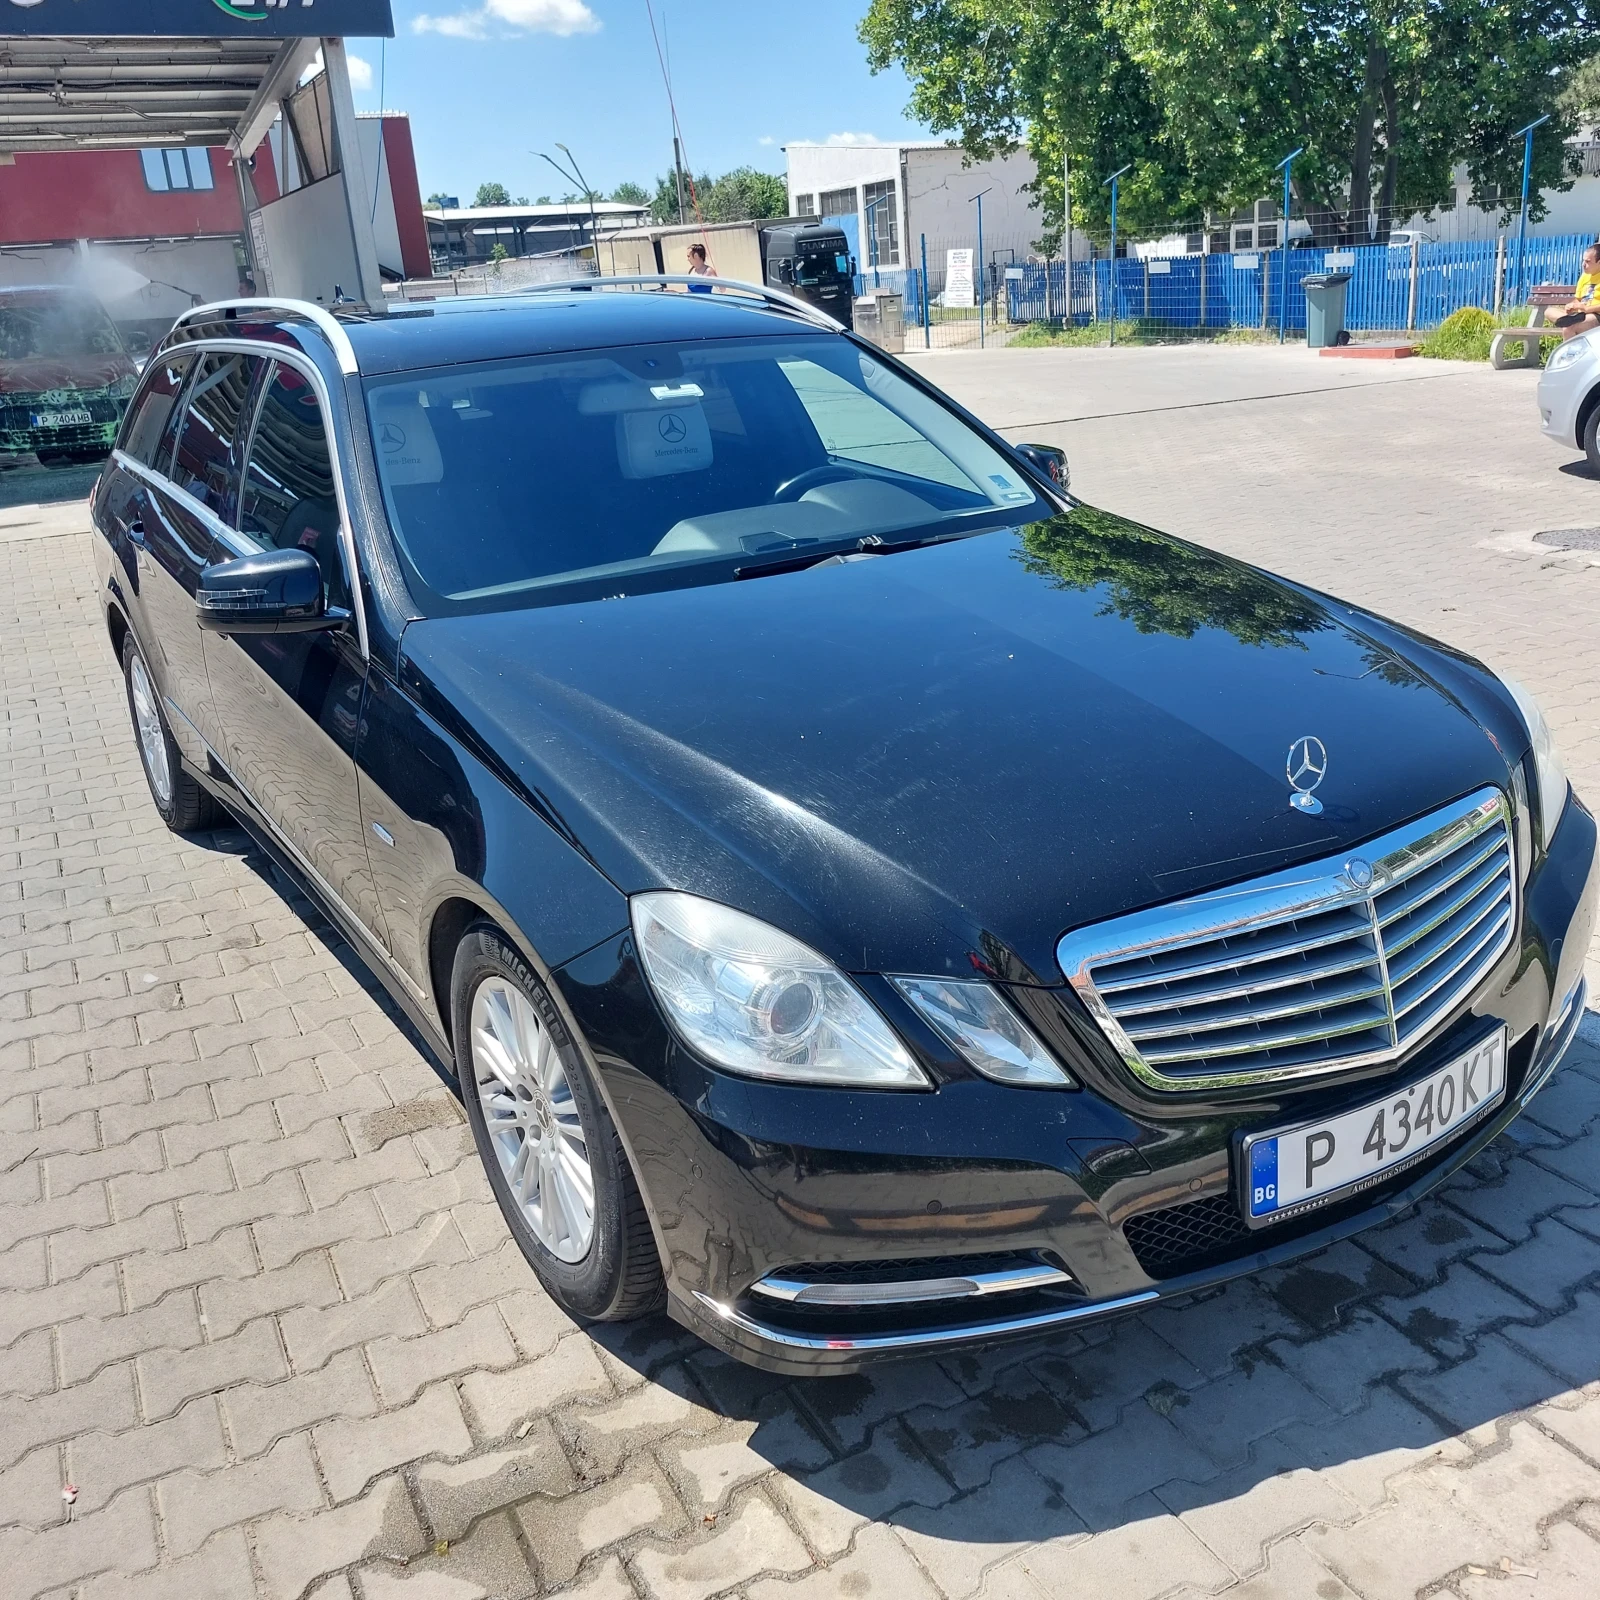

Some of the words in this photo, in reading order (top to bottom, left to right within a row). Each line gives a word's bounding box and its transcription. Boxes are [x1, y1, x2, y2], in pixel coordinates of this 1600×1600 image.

[41, 416, 48, 426] P
[385, 457, 421, 466] des-Benz
[654, 446, 699, 458] Mercedes-Benz
[501, 946, 566, 1042] MICHELIN
[566, 1063, 592, 1122] 225/55
[1305, 1130, 1336, 1189] P
[1350, 1169, 1393, 1194] Autohaus
[1392, 1149, 1432, 1175] Sternpark
[1253, 1183, 1276, 1205] BG
